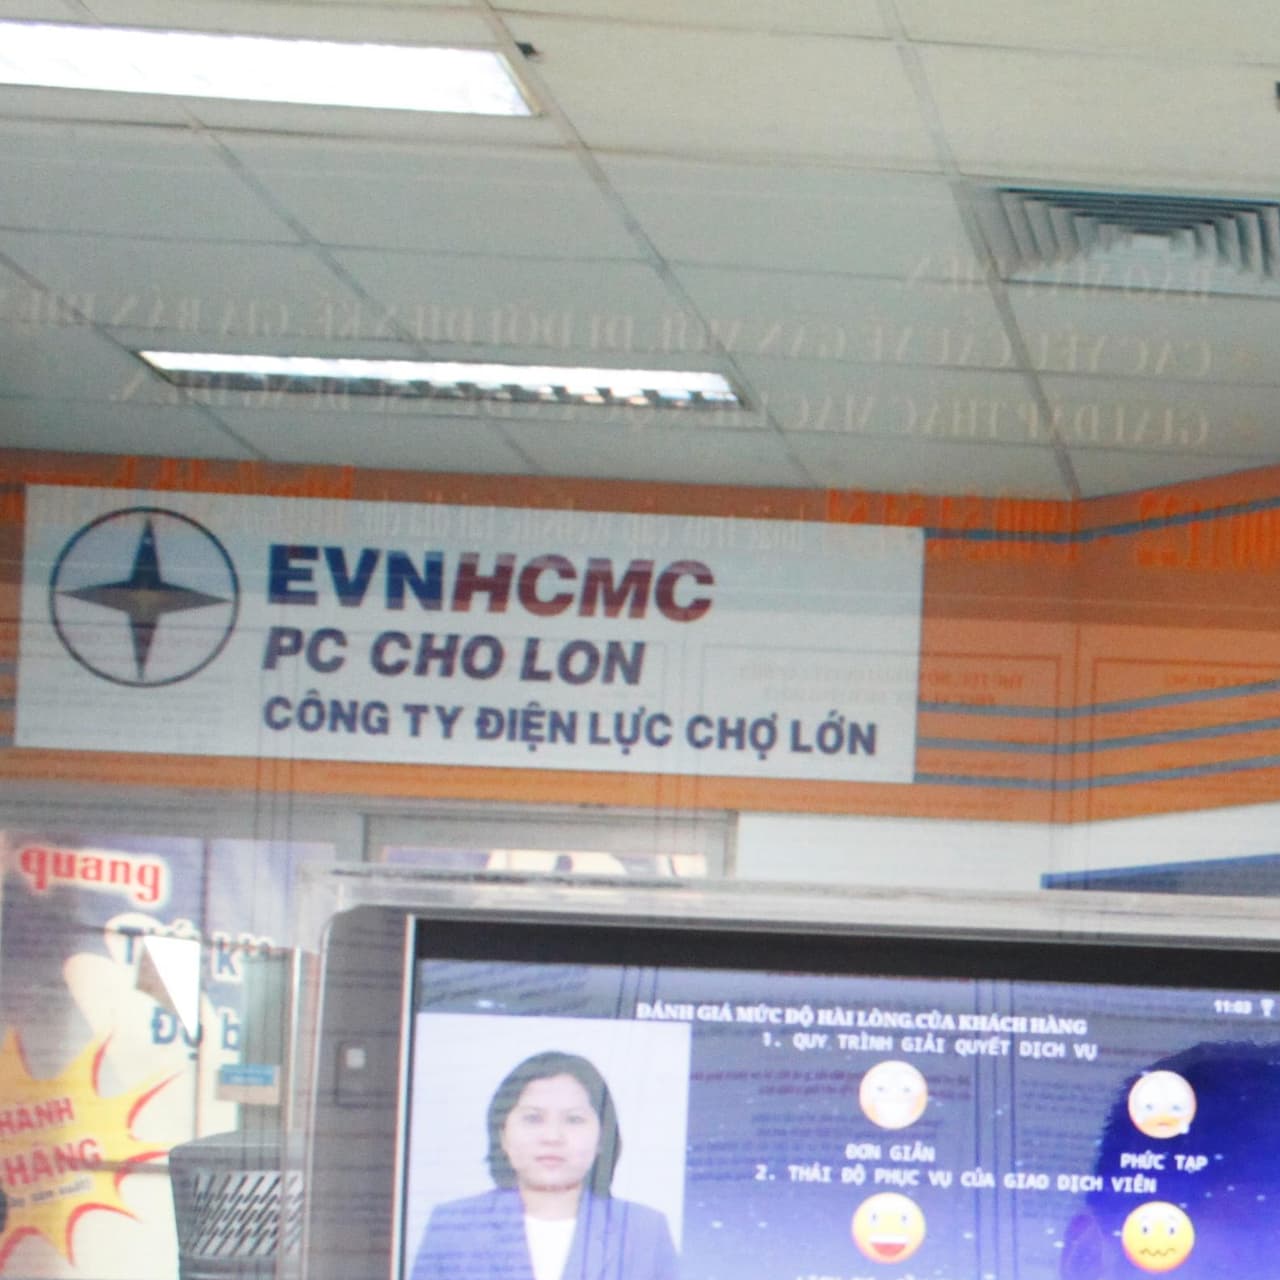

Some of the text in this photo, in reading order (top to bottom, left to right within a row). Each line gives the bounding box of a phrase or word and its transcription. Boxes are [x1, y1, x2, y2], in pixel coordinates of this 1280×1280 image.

[267, 543, 716, 622] EVNHCMC
[262, 627, 647, 686] PC CHO LON
[263, 696, 878, 761] CÔNG TY ĐIỆN LỰC CHỢ LỚN
[20, 847, 161, 902] quang
[636, 1002, 1088, 1036] ĐÁNH GIÁ MỨC ĐỘ HÀI LÒNG CỦA KHÁCH HÀNG
[793, 1033, 828, 1051] QUY
[837, 1029, 893, 1053] TRÌNH
[901, 1030, 945, 1054] GIẢI
[954, 1031, 1010, 1057] QUYẾT
[1073, 1042, 1098, 1062] VỤ
[889, 1140, 936, 1163] GIẢN
[1119, 1149, 1209, 1175] PHỨC TẠP
[755, 1165, 776, 1181] 2.
[787, 1161, 832, 1184] THÁI
[841, 1164, 866, 1187] ĐỘ
[874, 1166, 919, 1188] PHỤC
[928, 1169, 952, 1188] VỤ
[960, 1164, 994, 1189] CỦA
[1003, 1172, 1049, 1191] GIAO
[1111, 1173, 1158, 1194] VIÊN
